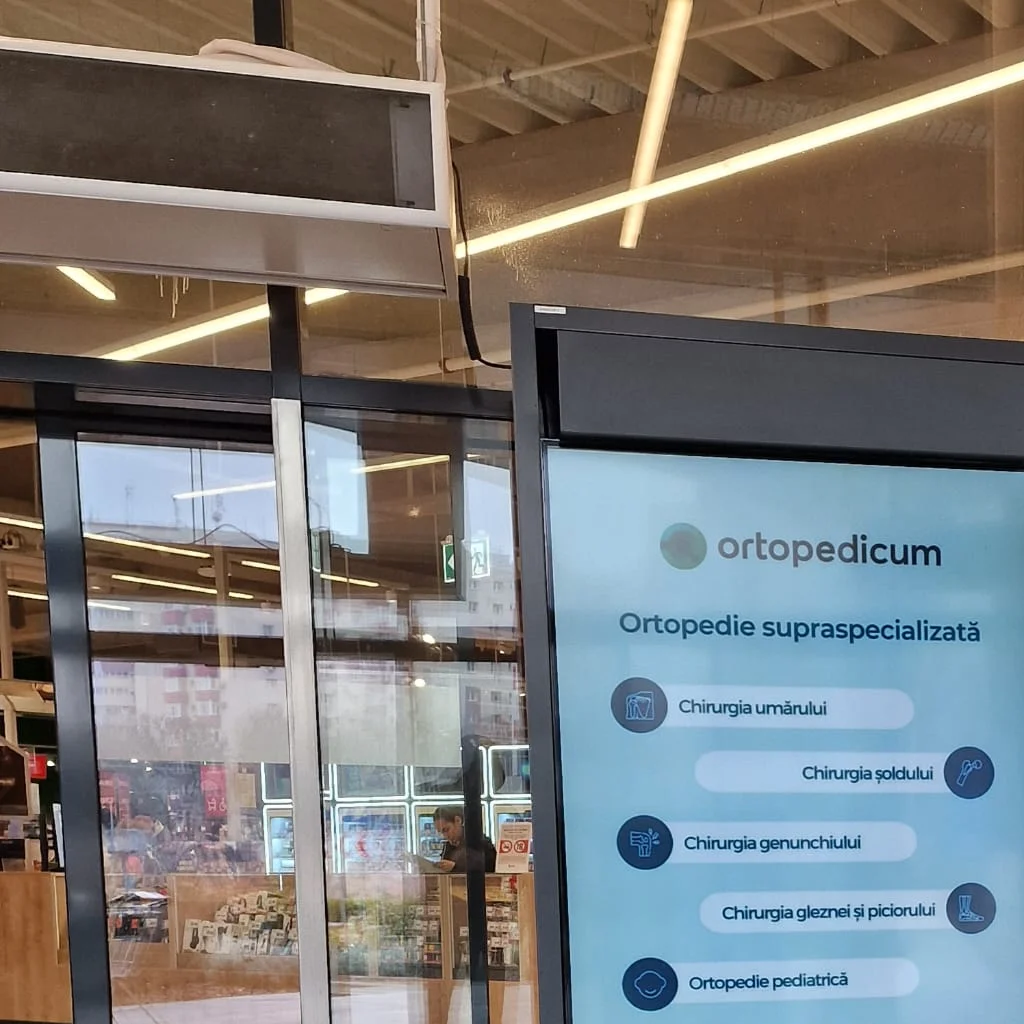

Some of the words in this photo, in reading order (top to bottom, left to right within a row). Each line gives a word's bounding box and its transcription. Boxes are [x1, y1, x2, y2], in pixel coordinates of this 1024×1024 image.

[718, 532, 942, 567] ortopedicum
[619, 612, 756, 640] Ortopedie
[762, 618, 981, 645] supraspecializată
[678, 699, 753, 718] Chirurgia
[755, 700, 827, 717] umărului
[803, 765, 873, 784] Chirurgia
[875, 765, 934, 785] șoldului
[684, 835, 757, 854] Chirurgia
[759, 834, 861, 854] genunchiului
[722, 904, 794, 923] Chirurgia
[796, 903, 851, 922] gleznei
[853, 903, 865, 922] și
[867, 902, 936, 921] piciorului
[689, 974, 770, 993] Ortopedie
[772, 972, 849, 992] pediatrică
